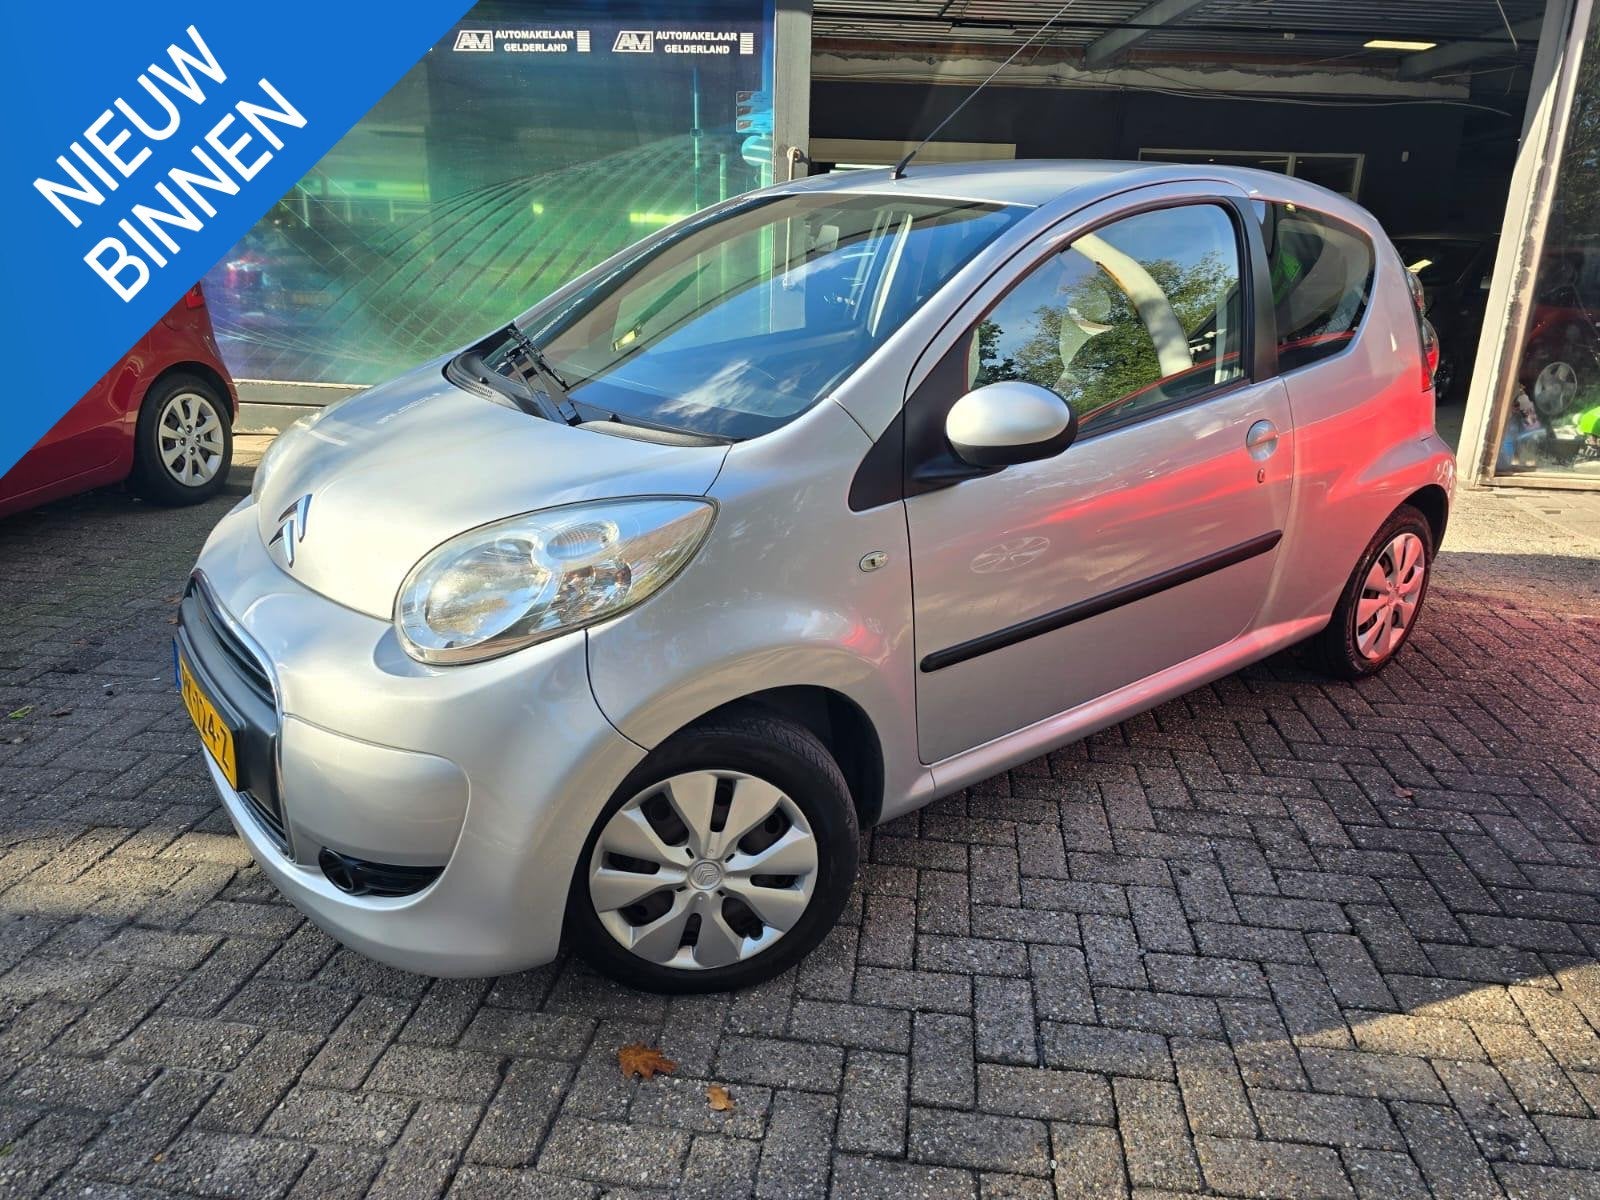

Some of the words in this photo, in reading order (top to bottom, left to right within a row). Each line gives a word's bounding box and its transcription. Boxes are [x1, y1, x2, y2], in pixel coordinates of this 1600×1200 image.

[495, 30, 574, 40] AUTOMAKELAAR
[655, 31, 738, 42] AUTOMAKELAAR
[456, 31, 492, 51] AM
[614, 32, 653, 52] AM
[503, 42, 568, 53] GELDERLAND
[664, 44, 730, 55] GELDERLAND
